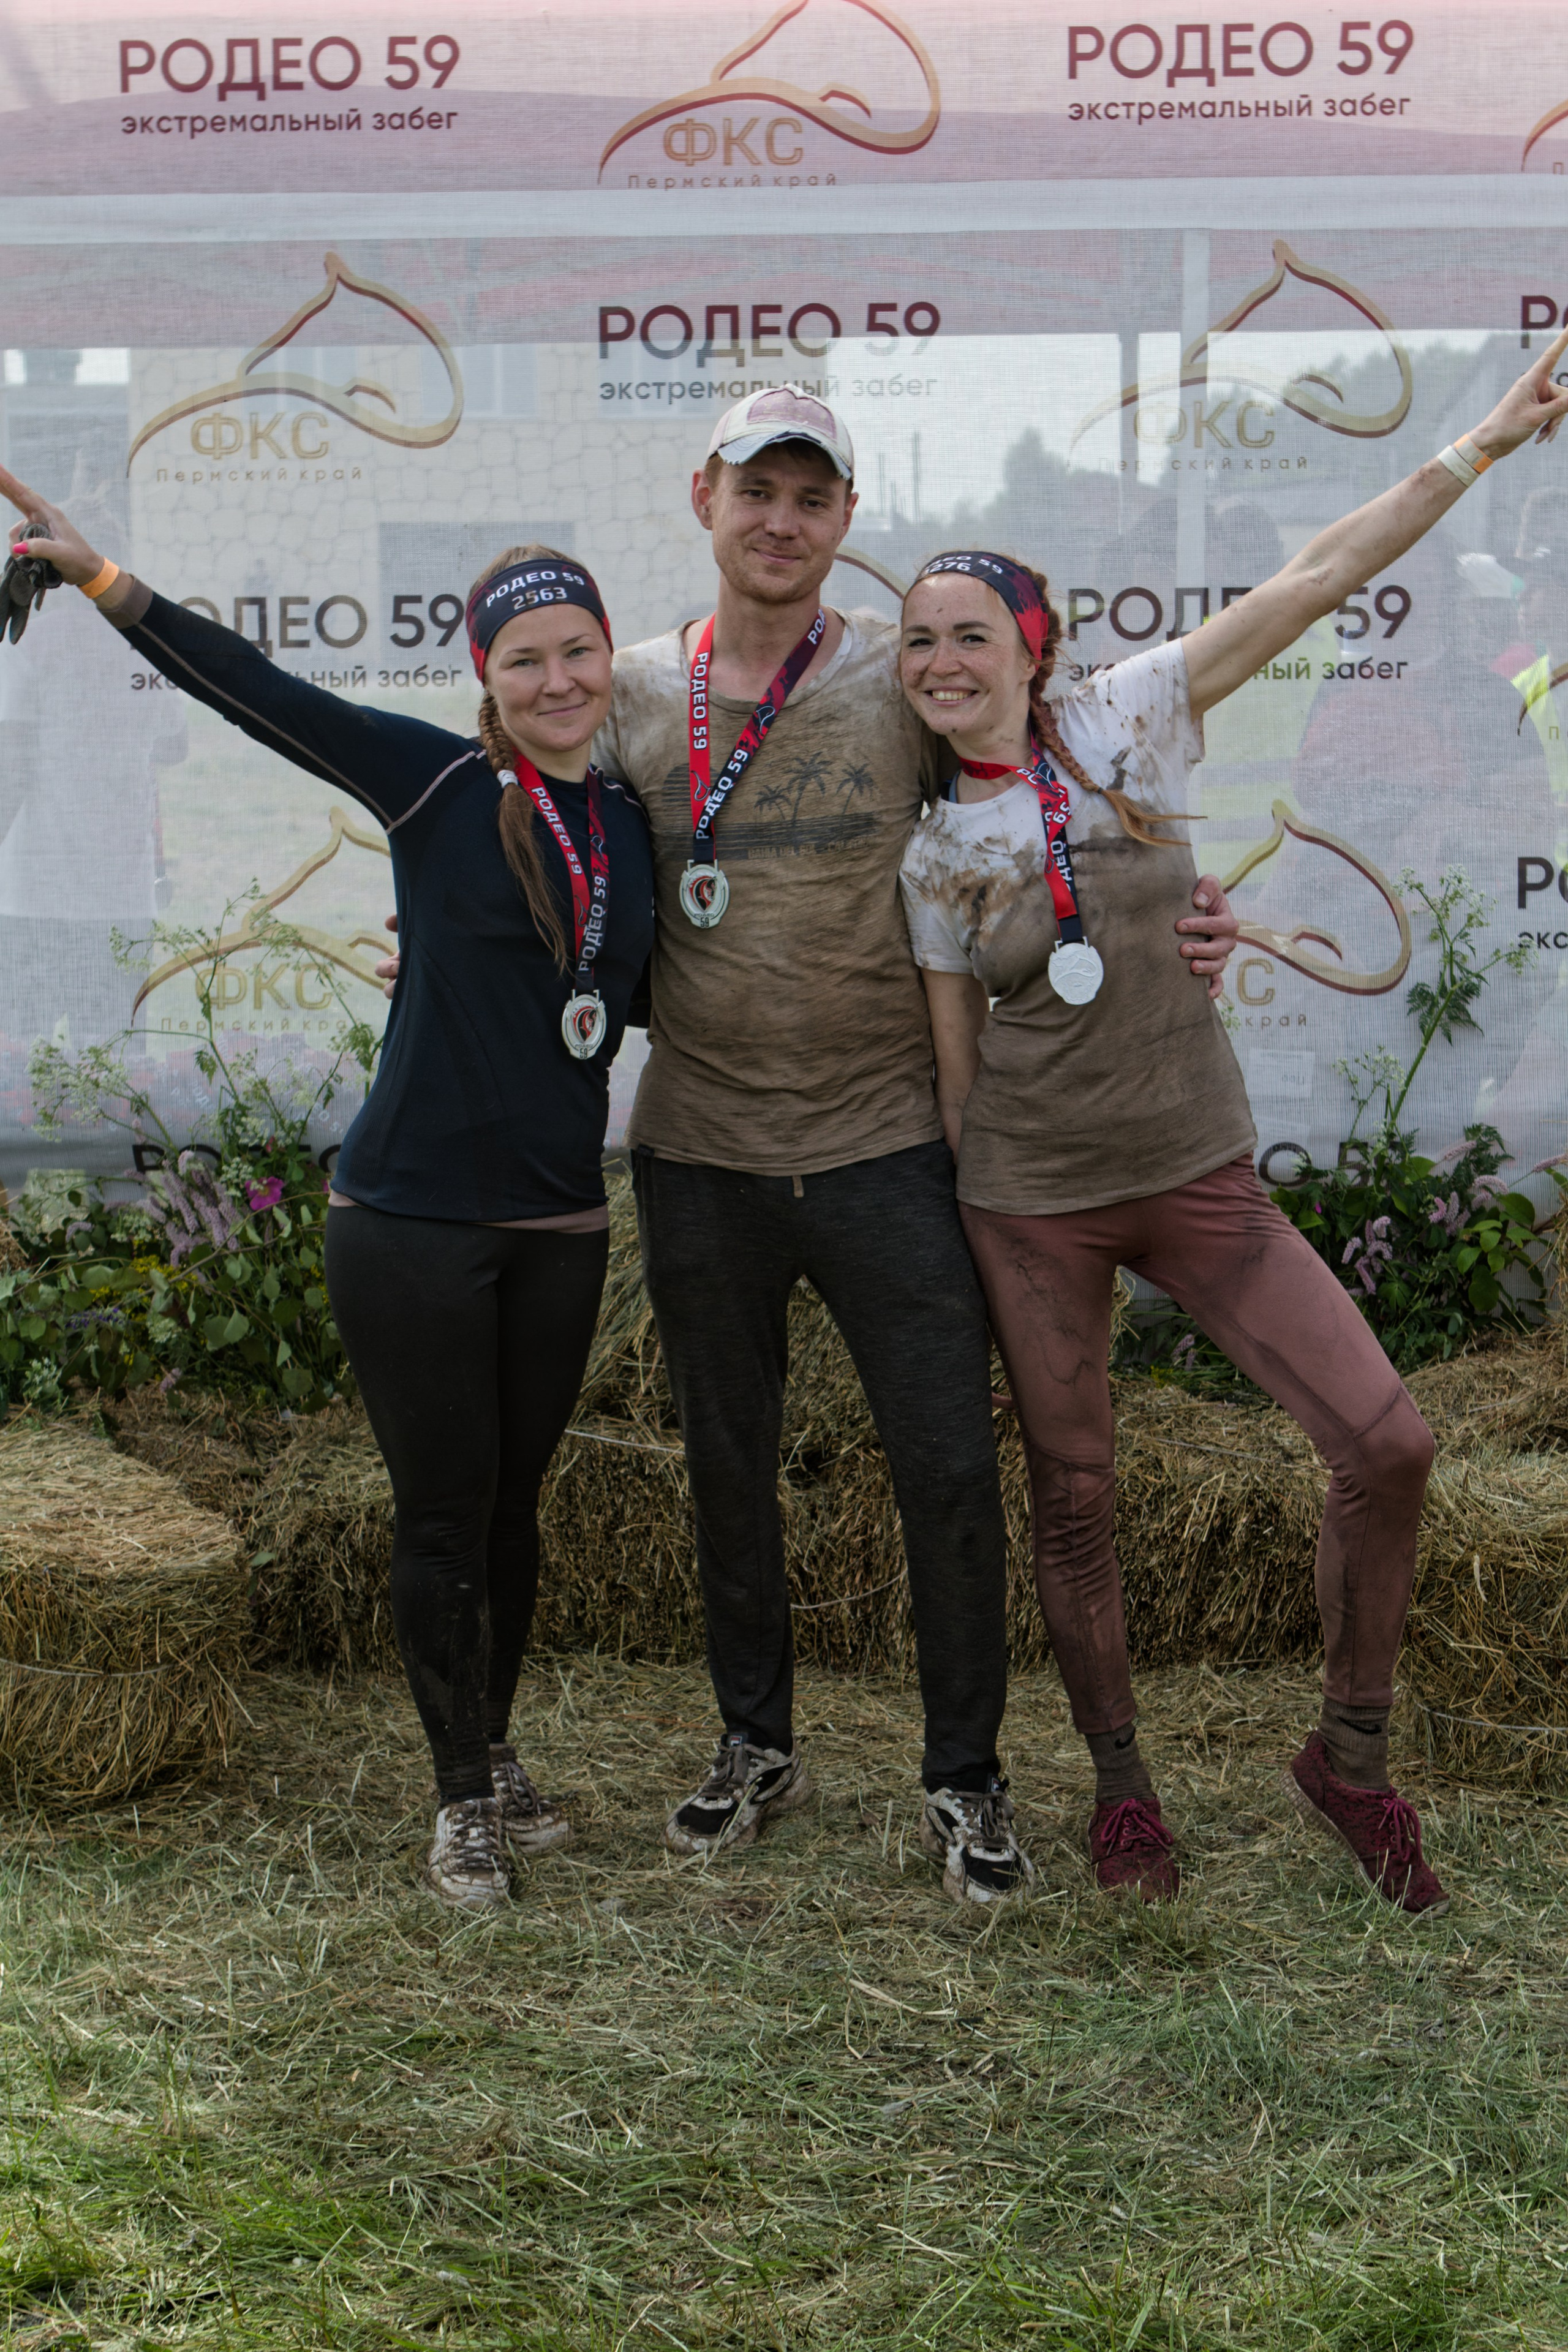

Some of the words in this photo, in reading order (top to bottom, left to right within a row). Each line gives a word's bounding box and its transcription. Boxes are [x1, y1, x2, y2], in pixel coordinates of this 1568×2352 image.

[120, 37, 361, 102] РОДЕО
[385, 35, 460, 90] 59
[1068, 21, 1314, 88] РОДЕО
[1336, 19, 1414, 76] 59
[122, 108, 362, 139] экстремальный
[372, 107, 458, 130] забег
[1068, 94, 1313, 125] экстремальный
[1323, 92, 1411, 117] забег
[663, 117, 804, 167] ФКС
[628, 174, 761, 190] Пермский
[773, 173, 837, 190] край
[599, 303, 842, 368] РОДЕО
[864, 301, 941, 357] 59
[851, 373, 938, 397] забег
[190, 411, 330, 460] ФКС
[156, 468, 287, 484] Пермский
[300, 467, 363, 483] край
[1244, 456, 1308, 472] край
[979, 559, 1003, 574] 59
[486, 571, 556, 607] РОДЕО
[562, 573, 584, 586] 59
[512, 587, 567, 610] 2563
[390, 594, 464, 648] 59
[1335, 585, 1411, 639] 59
[378, 665, 462, 688] забег
[691, 652, 708, 720] РОДЕО
[1322, 656, 1408, 680] забег
[693, 724, 707, 750] 59
[695, 775, 732, 840] РОДЕО
[728, 748, 748, 774] 59
[531, 786, 571, 848] РОДЕО
[567, 851, 582, 875] 59
[578, 903, 604, 973] РОДЕО
[594, 876, 606, 900] 59
[195, 963, 331, 1010] ФКС
[1246, 1014, 1307, 1030] край
